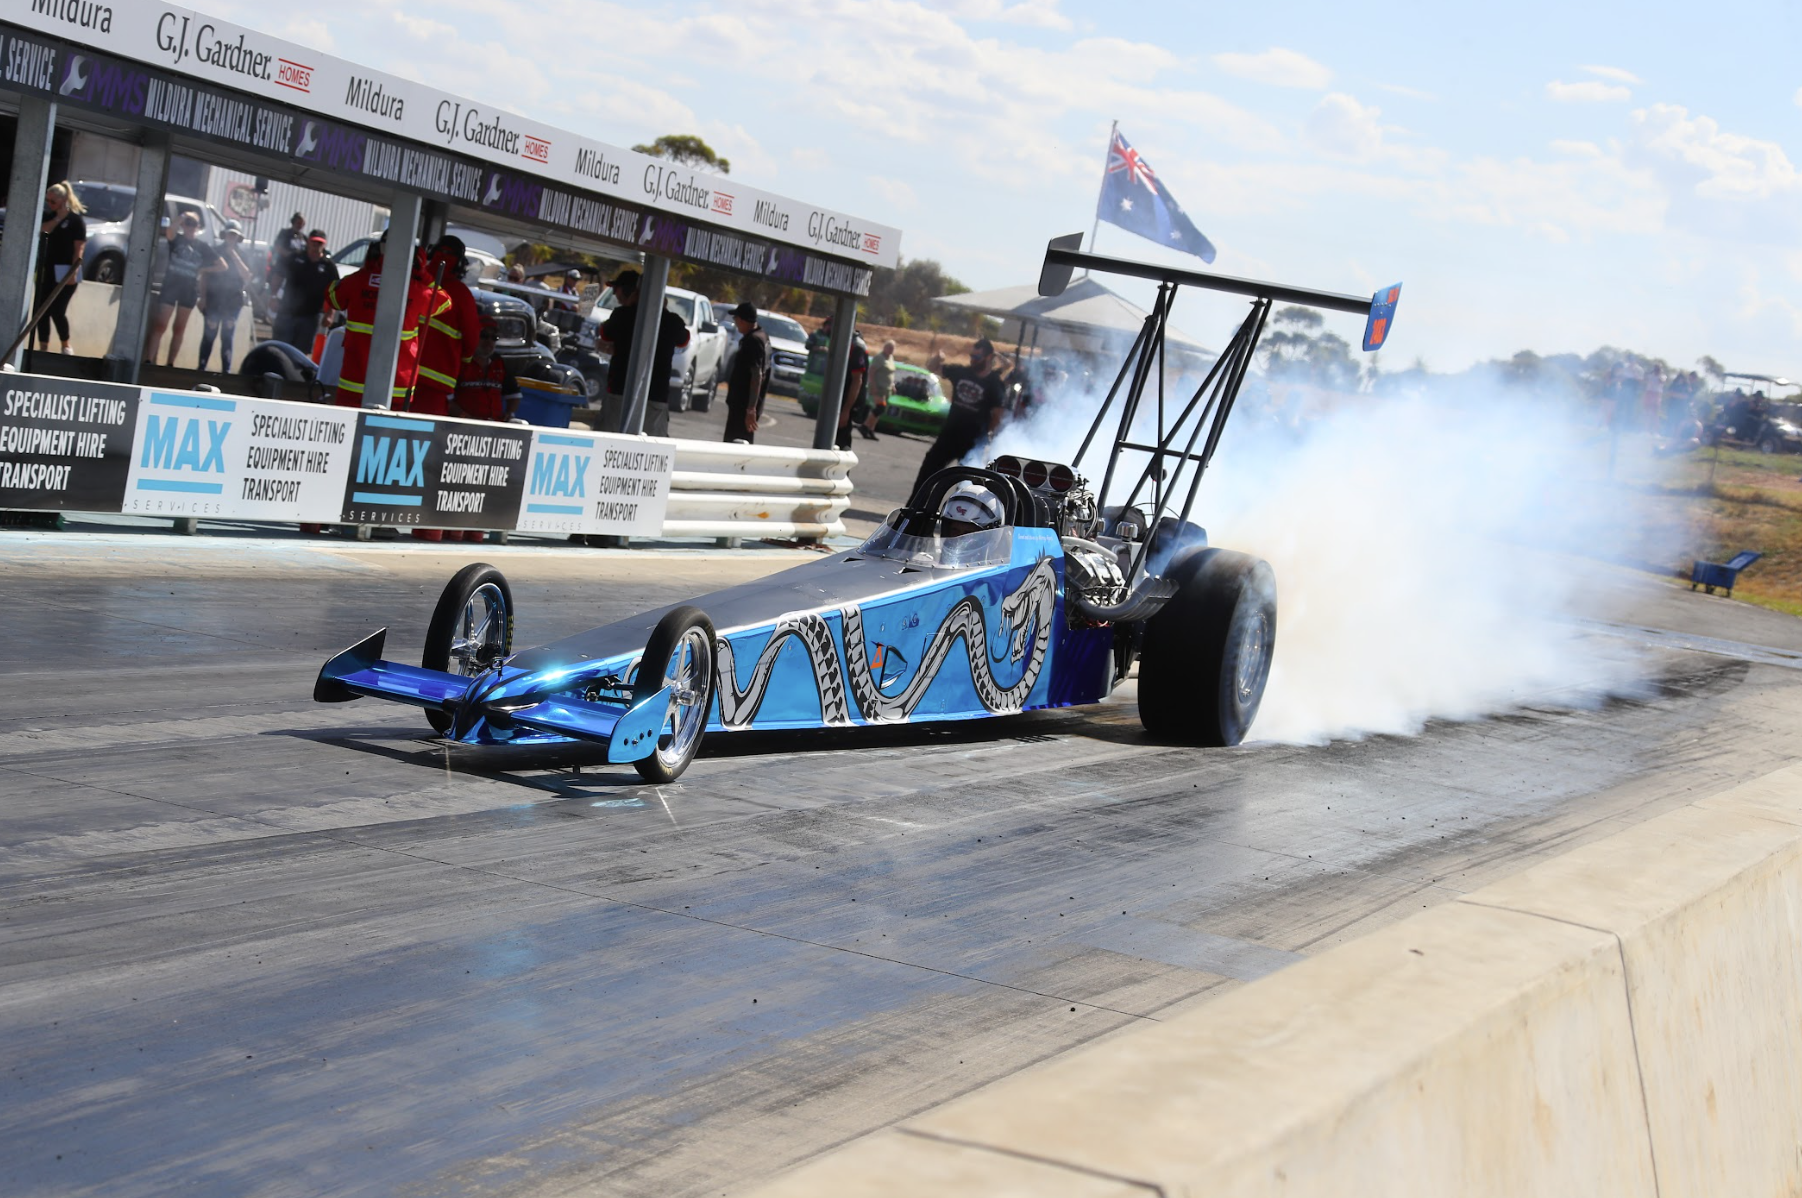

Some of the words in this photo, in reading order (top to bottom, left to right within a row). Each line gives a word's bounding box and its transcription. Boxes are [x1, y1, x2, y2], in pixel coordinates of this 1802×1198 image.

[5, 37, 56, 91] SERVICE
[156, 12, 190, 64] G.J.
[278, 64, 311, 87] HOMES
[86, 63, 148, 115] MMS
[144, 77, 193, 128] MILDURA
[193, 91, 253, 144] MECHANICAL
[253, 107, 293, 153] SERVICE
[345, 76, 404, 121] Mildura
[436, 100, 460, 144] G.J.
[524, 141, 549, 159] HOMES
[316, 124, 366, 172] MMS
[362, 138, 401, 181] MILDURA
[400, 148, 451, 194] MECHANICAL
[450, 162, 482, 202] SERVICE
[575, 148, 619, 185] Mildura
[643, 164, 663, 202] G.J.
[713, 196, 733, 211] HOMES
[501, 178, 543, 217] MMS
[538, 187, 571, 226] MILDURA
[569, 196, 612, 236] MECHANICAL
[611, 207, 639, 243] SERVICE
[753, 200, 789, 231] Mildura
[653, 216, 687, 254] MMS
[742, 241, 766, 274] SERVICE
[807, 211, 824, 245] G.J.
[864, 237, 880, 251] HOMES
[4, 389, 77, 421] SPECIALIST
[78, 397, 126, 425] LIFTING
[0, 426, 75, 456] EQUIPMENT
[76, 433, 107, 458] HIRE
[140, 414, 232, 474] MAX
[251, 414, 308, 441] SPECIALIST
[309, 419, 346, 444] LIFTING
[445, 433, 492, 458] SPECIALIST
[492, 437, 523, 461] LIFTING
[246, 446, 305, 472] EQUIPMENT
[305, 450, 329, 474] HIRE
[356, 435, 431, 488] MAX
[440, 461, 490, 486] EQUIPMENT
[489, 466, 509, 487] HIRE
[530, 452, 590, 498] MAX
[603, 449, 642, 472] SPECIALIST
[643, 453, 668, 473] LIFTING
[242, 477, 301, 502] TRANSPORT
[436, 490, 486, 514] TRANSPORT
[599, 475, 639, 497] EQUIPMENT
[638, 478, 657, 497] HIRE
[132, 499, 221, 514] SERVICES
[349, 510, 420, 523] SERVICES
[595, 501, 637, 522] TRANSPORT
[523, 520, 582, 532] SERVICES
